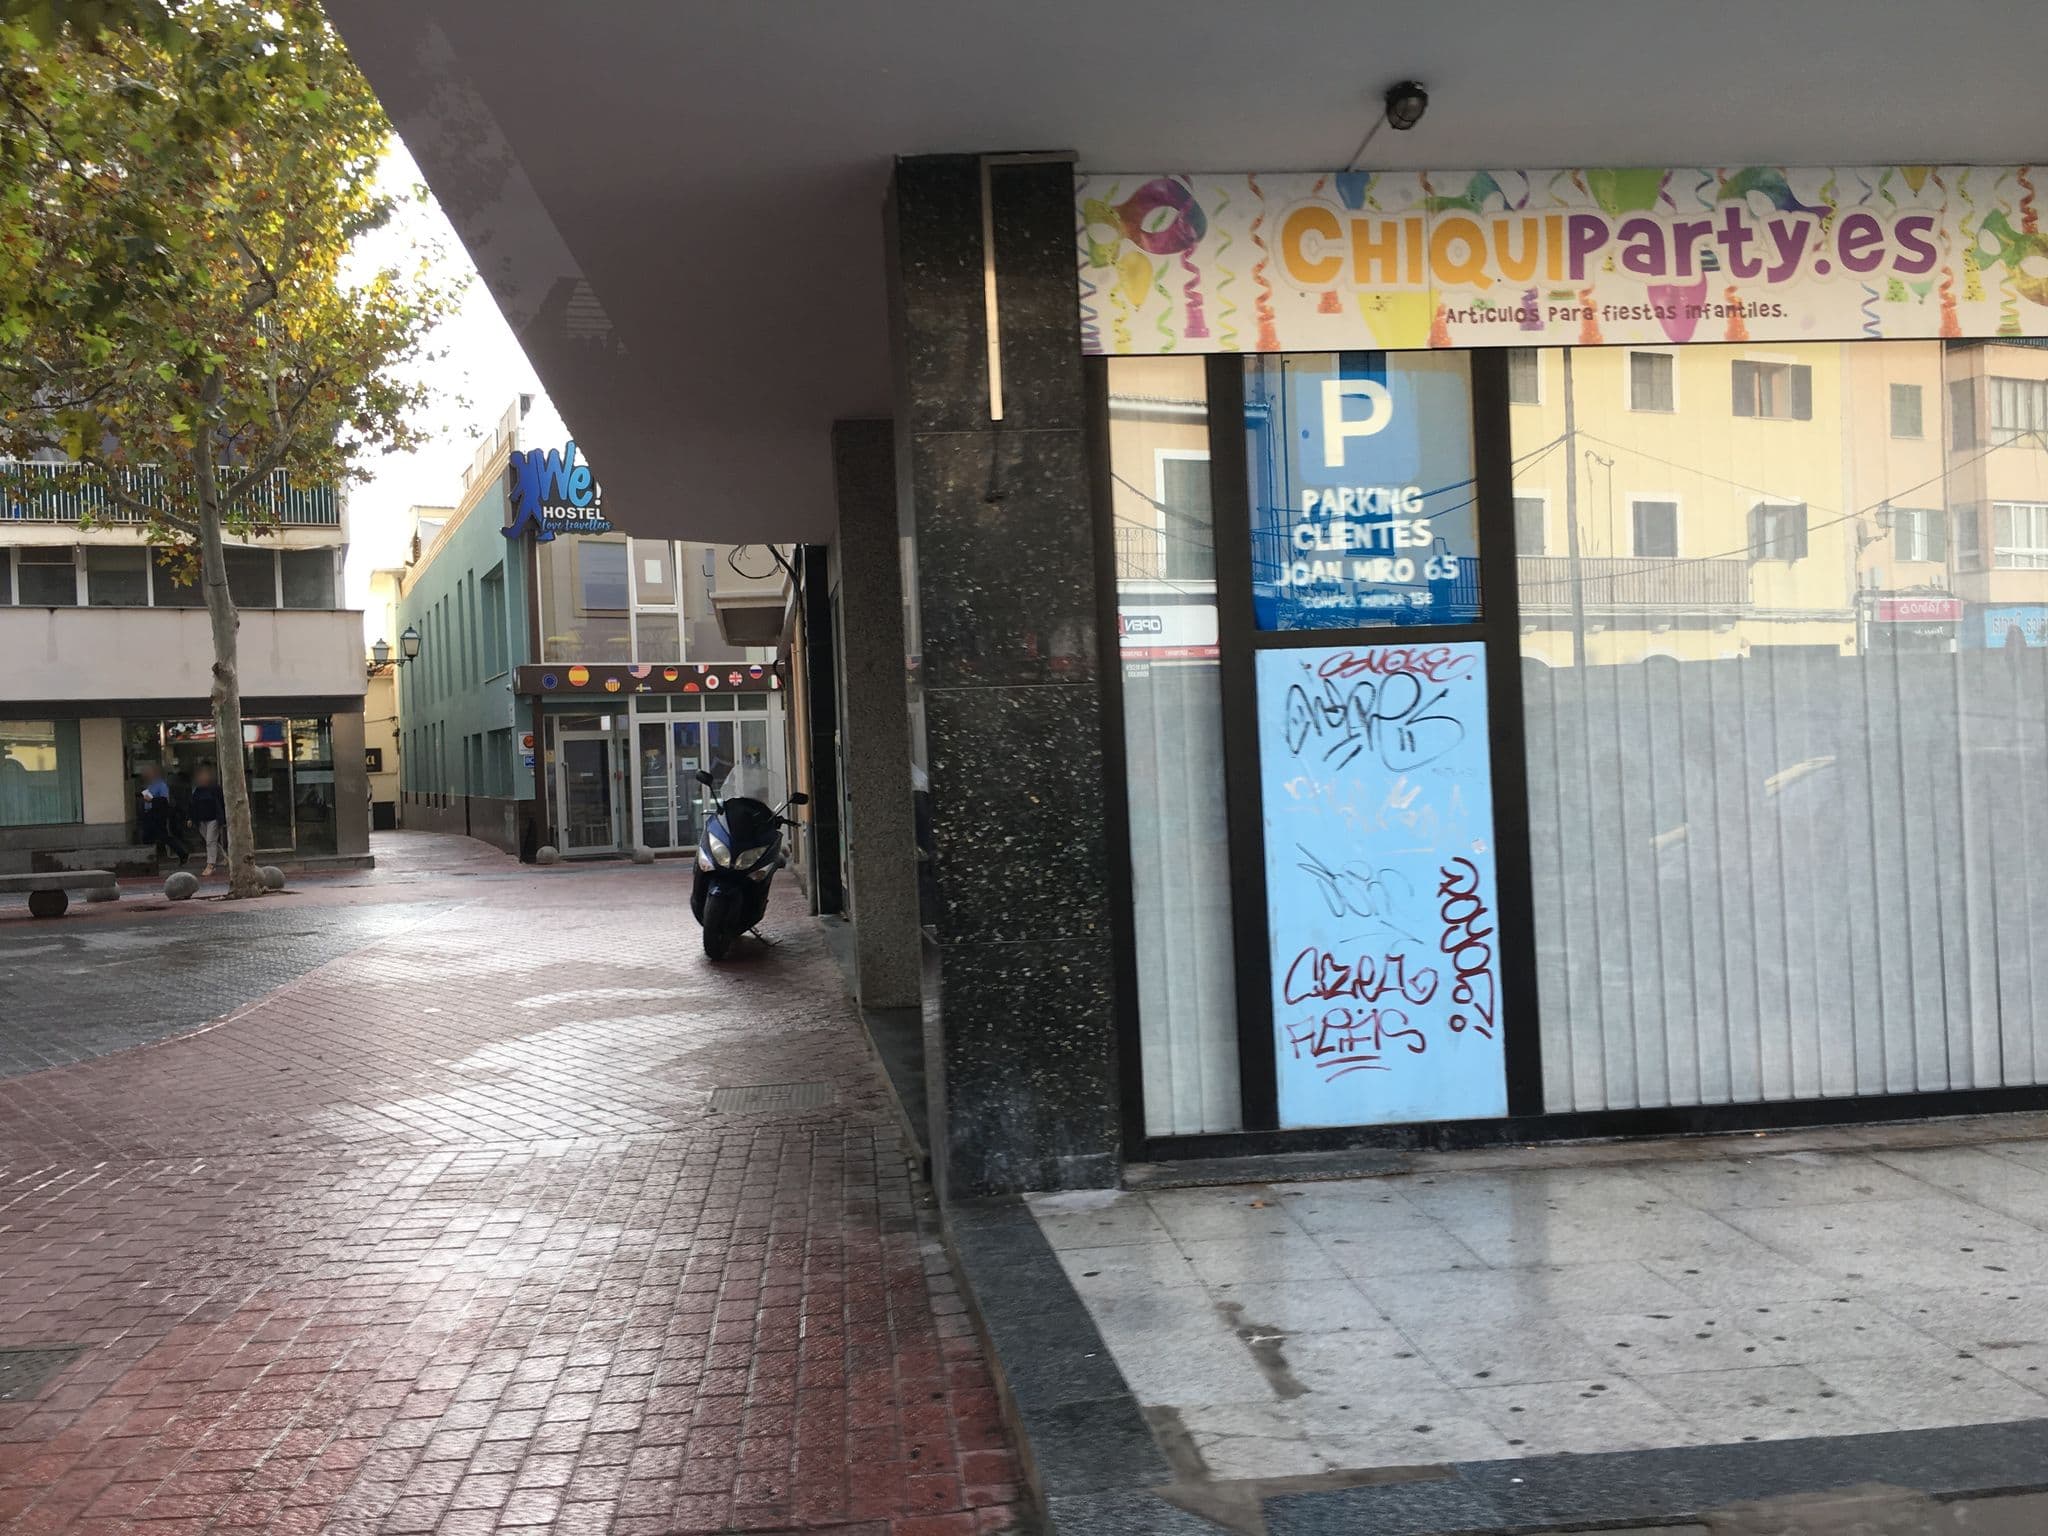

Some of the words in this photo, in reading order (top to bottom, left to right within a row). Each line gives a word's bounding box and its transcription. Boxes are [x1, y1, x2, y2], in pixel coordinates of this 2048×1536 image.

[1601, 301, 1677, 321] fiestas
[1685, 300, 1789, 320] infantiles.
[1321, 378, 1393, 468] P
[543, 506, 605, 520] HOSTEL
[1302, 486, 1425, 518] PARKING
[565, 519, 612, 531] travellers
[1293, 519, 1433, 551] CLIENTES
[1275, 559, 1344, 587] JOAN
[1352, 557, 1415, 583] MIRO
[1423, 554, 1460, 581] 65
